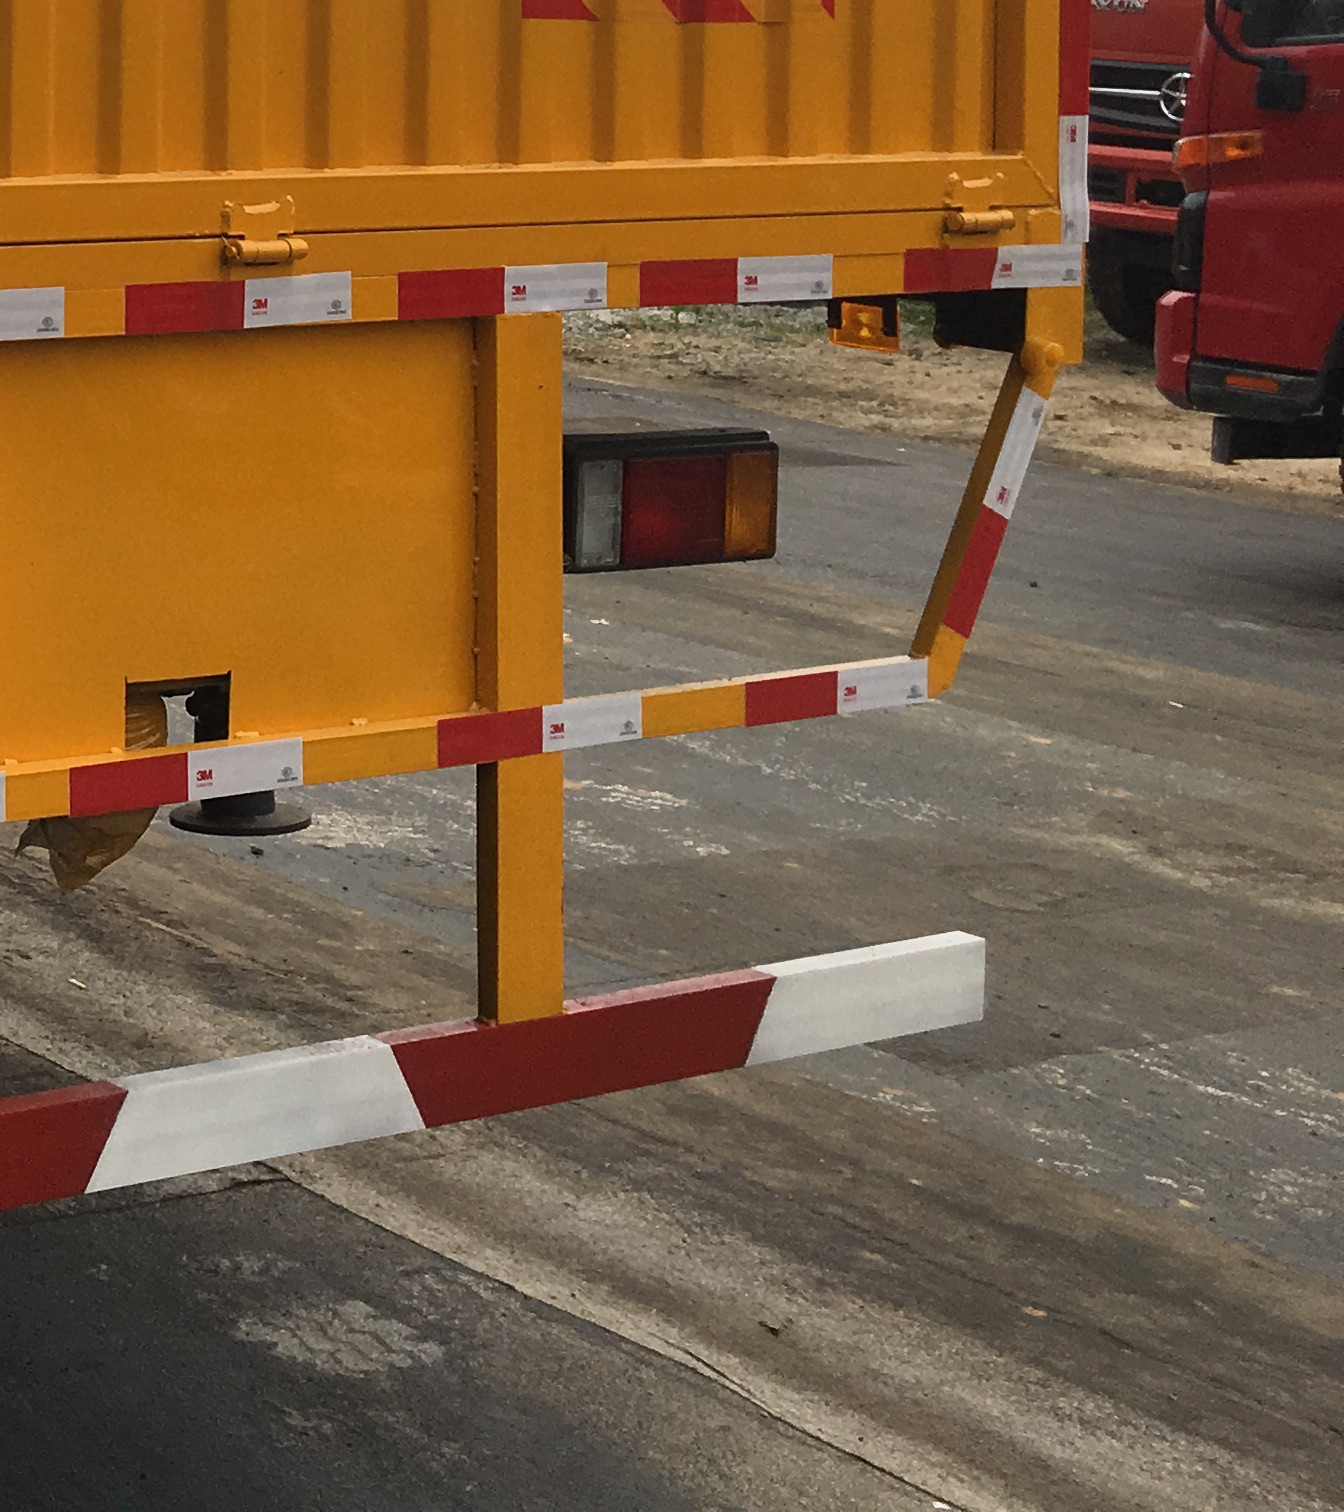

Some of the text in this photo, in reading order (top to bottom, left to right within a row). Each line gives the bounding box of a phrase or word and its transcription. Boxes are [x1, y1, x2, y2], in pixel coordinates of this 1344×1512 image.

[511, 285, 526, 296] 3M
[252, 298, 269, 310] 3M
[550, 723, 564, 734] 3M
[197, 769, 213, 782] 3M
